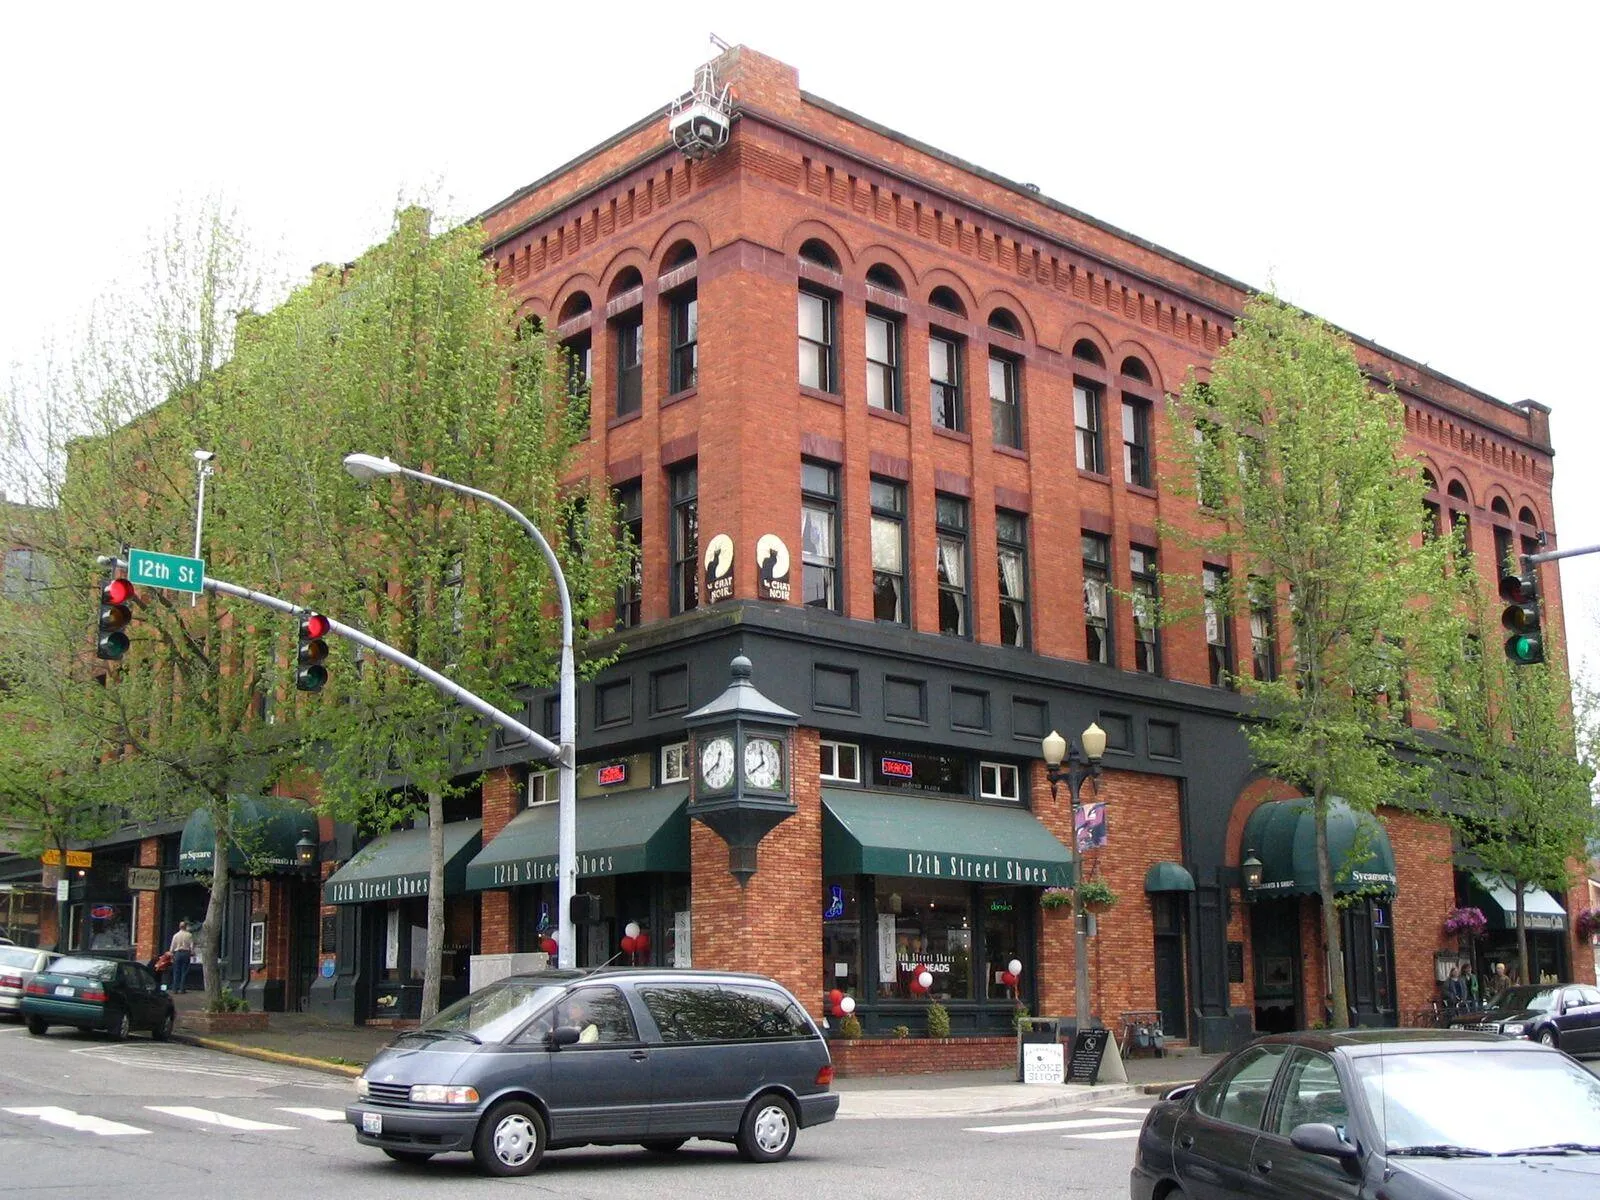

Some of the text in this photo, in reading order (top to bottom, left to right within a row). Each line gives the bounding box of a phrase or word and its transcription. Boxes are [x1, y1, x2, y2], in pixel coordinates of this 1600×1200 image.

[138, 559, 195, 584] 12th St
[714, 576, 733, 589] CHAT
[771, 580, 791, 591] CHAT
[711, 587, 733, 601] NOIR
[769, 588, 790, 601] NOIR
[188, 850, 212, 861] Square
[493, 863, 519, 884] 12th
[526, 861, 560, 880] Stree
[907, 853, 1048, 882] 12th Street Shoes
[1352, 870, 1388, 883] Sycamore
[333, 876, 428, 901] 12th Street Shoes
[912, 952, 933, 962] Street
[936, 953, 956, 962] Shoes
[901, 962, 950, 973] TUR HEADS
[1026, 1063, 1062, 1072] SMOKE
[1028, 1072, 1060, 1081] SHOP
